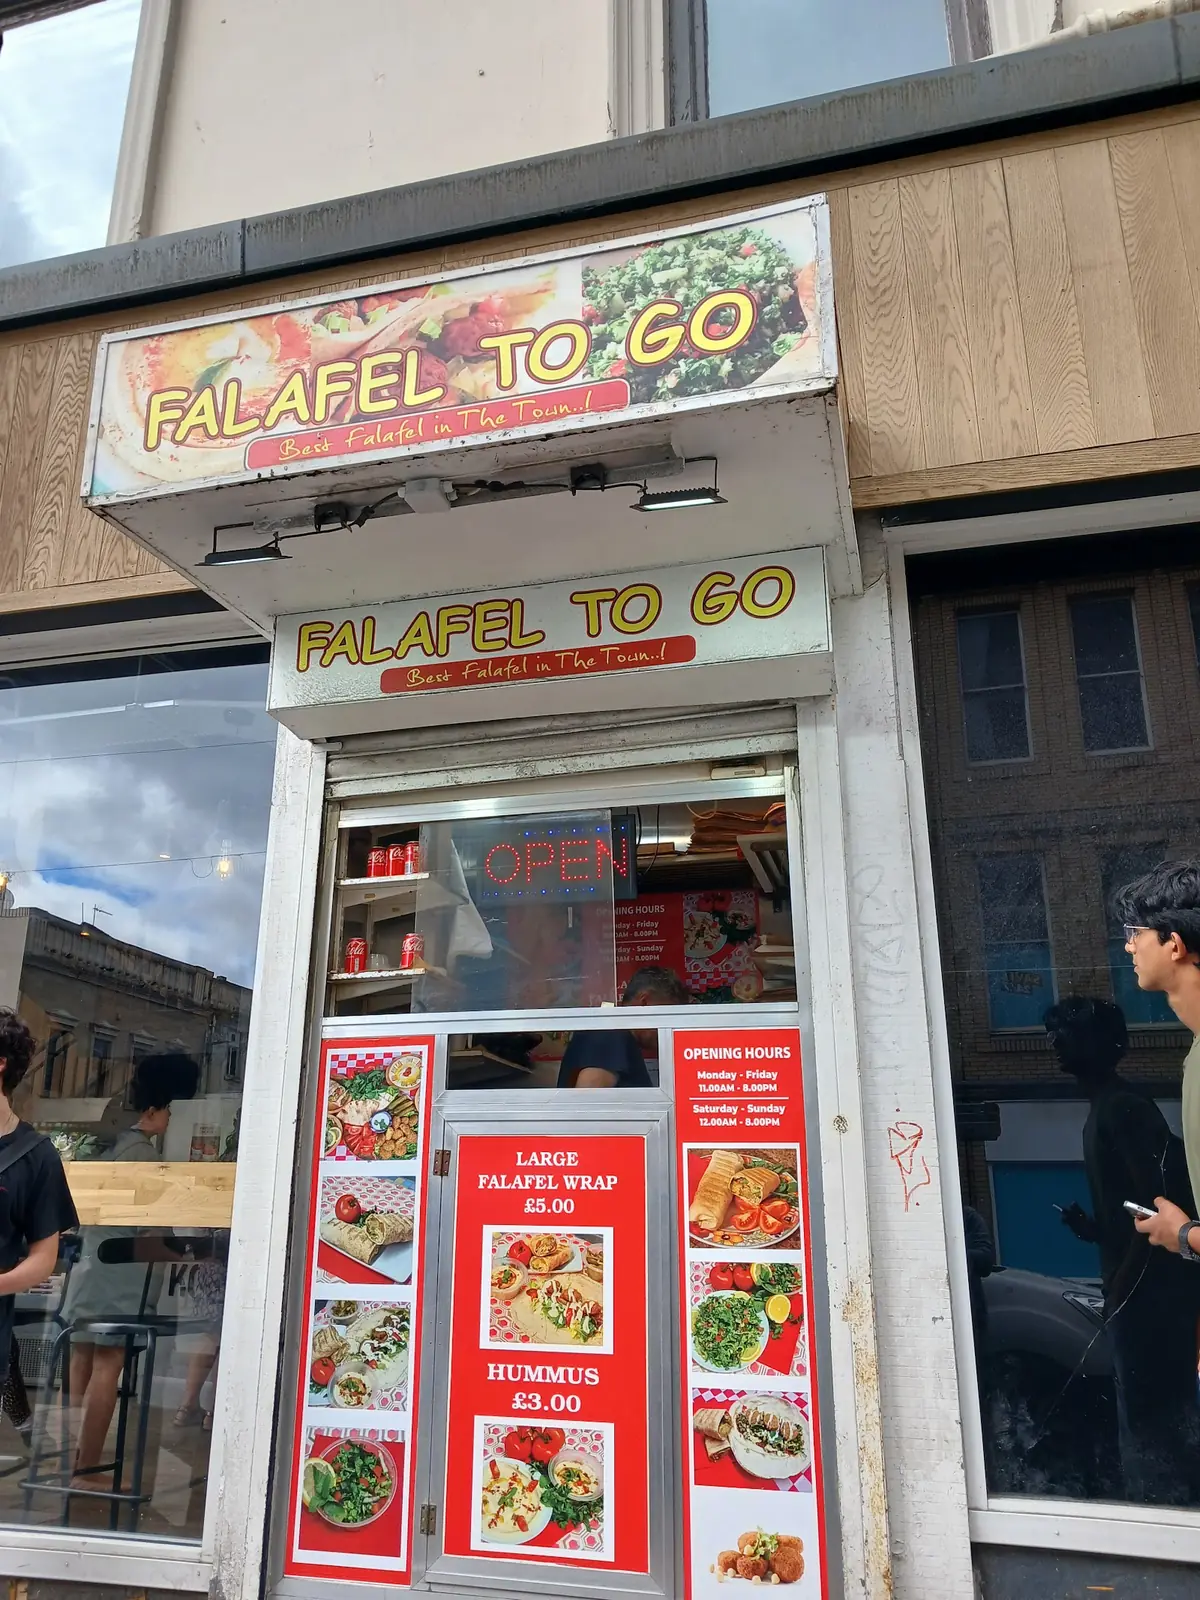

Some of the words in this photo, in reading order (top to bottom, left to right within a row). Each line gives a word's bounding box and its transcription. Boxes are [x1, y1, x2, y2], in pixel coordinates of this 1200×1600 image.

[144, 346, 447, 451] FALAFEL
[478, 318, 591, 391] TO
[624, 288, 759, 367] GO
[279, 437, 333, 460] Best
[345, 417, 423, 448] Falafel
[434, 415, 452, 434] in
[457, 408, 508, 429] The
[296, 597, 546, 673] FALAFEL
[570, 583, 662, 637] TO
[690, 565, 795, 626] GO
[406, 669, 452, 687] Best
[462, 658, 528, 682] Falafel
[536, 658, 552, 673] in
[555, 651, 597, 669] The
[484, 837, 628, 886] OPEN
[635, 905, 666, 915] HOURS
[636, 921, 659, 929] Friday
[637, 945, 664, 954] Sunday
[683, 1047, 742, 1060] OPENING
[745, 1047, 791, 1059] HOURS
[697, 1071, 737, 1081] Monday
[745, 1070, 778, 1081] Friday
[699, 1084, 735, 1092] 11.00AM
[743, 1083, 778, 1092] 8.00PM
[693, 1104, 739, 1114] Saturday
[747, 1104, 786, 1114] Sunday
[699, 1118, 737, 1127] 12.00AM
[745, 1118, 780, 1127] 8.00PM
[516, 1152, 579, 1167] LARGE
[478, 1175, 558, 1190] FALAFEL
[564, 1175, 618, 1191] WRAP
[524, 1198, 575, 1214] £5.00
[487, 1363, 600, 1386] HUMMUS
[511, 1392, 582, 1413] £3.00
